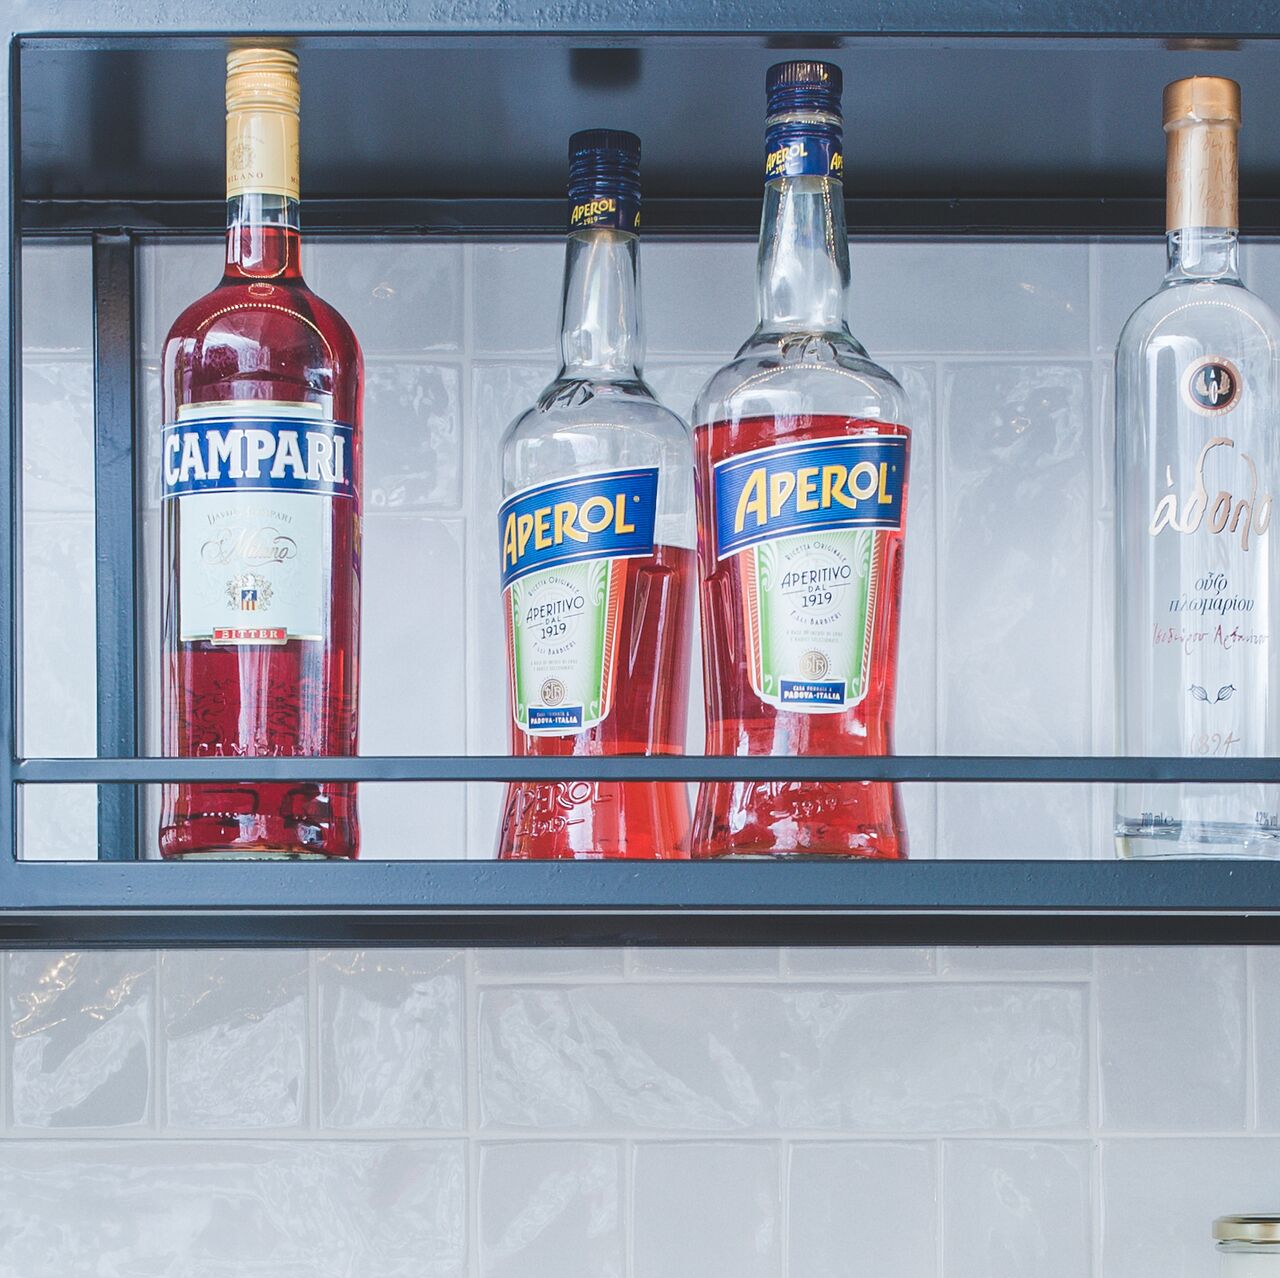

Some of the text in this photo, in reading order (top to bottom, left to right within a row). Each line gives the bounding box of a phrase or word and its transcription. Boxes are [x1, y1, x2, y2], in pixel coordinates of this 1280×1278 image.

[765, 143, 808, 175] APEROL
[571, 198, 616, 225] APEROL
[166, 428, 346, 487] CAMPARI
[734, 461, 893, 534] APEROL
[503, 493, 635, 574] APEROL
[781, 564, 852, 590] APERITIVO
[807, 584, 827, 593] DAL
[526, 595, 585, 624] APERITIVO
[801, 591, 833, 608] 1919
[540, 621, 567, 640] 1919
[545, 614, 562, 626] DAL
[222, 629, 278, 640] BITTER
